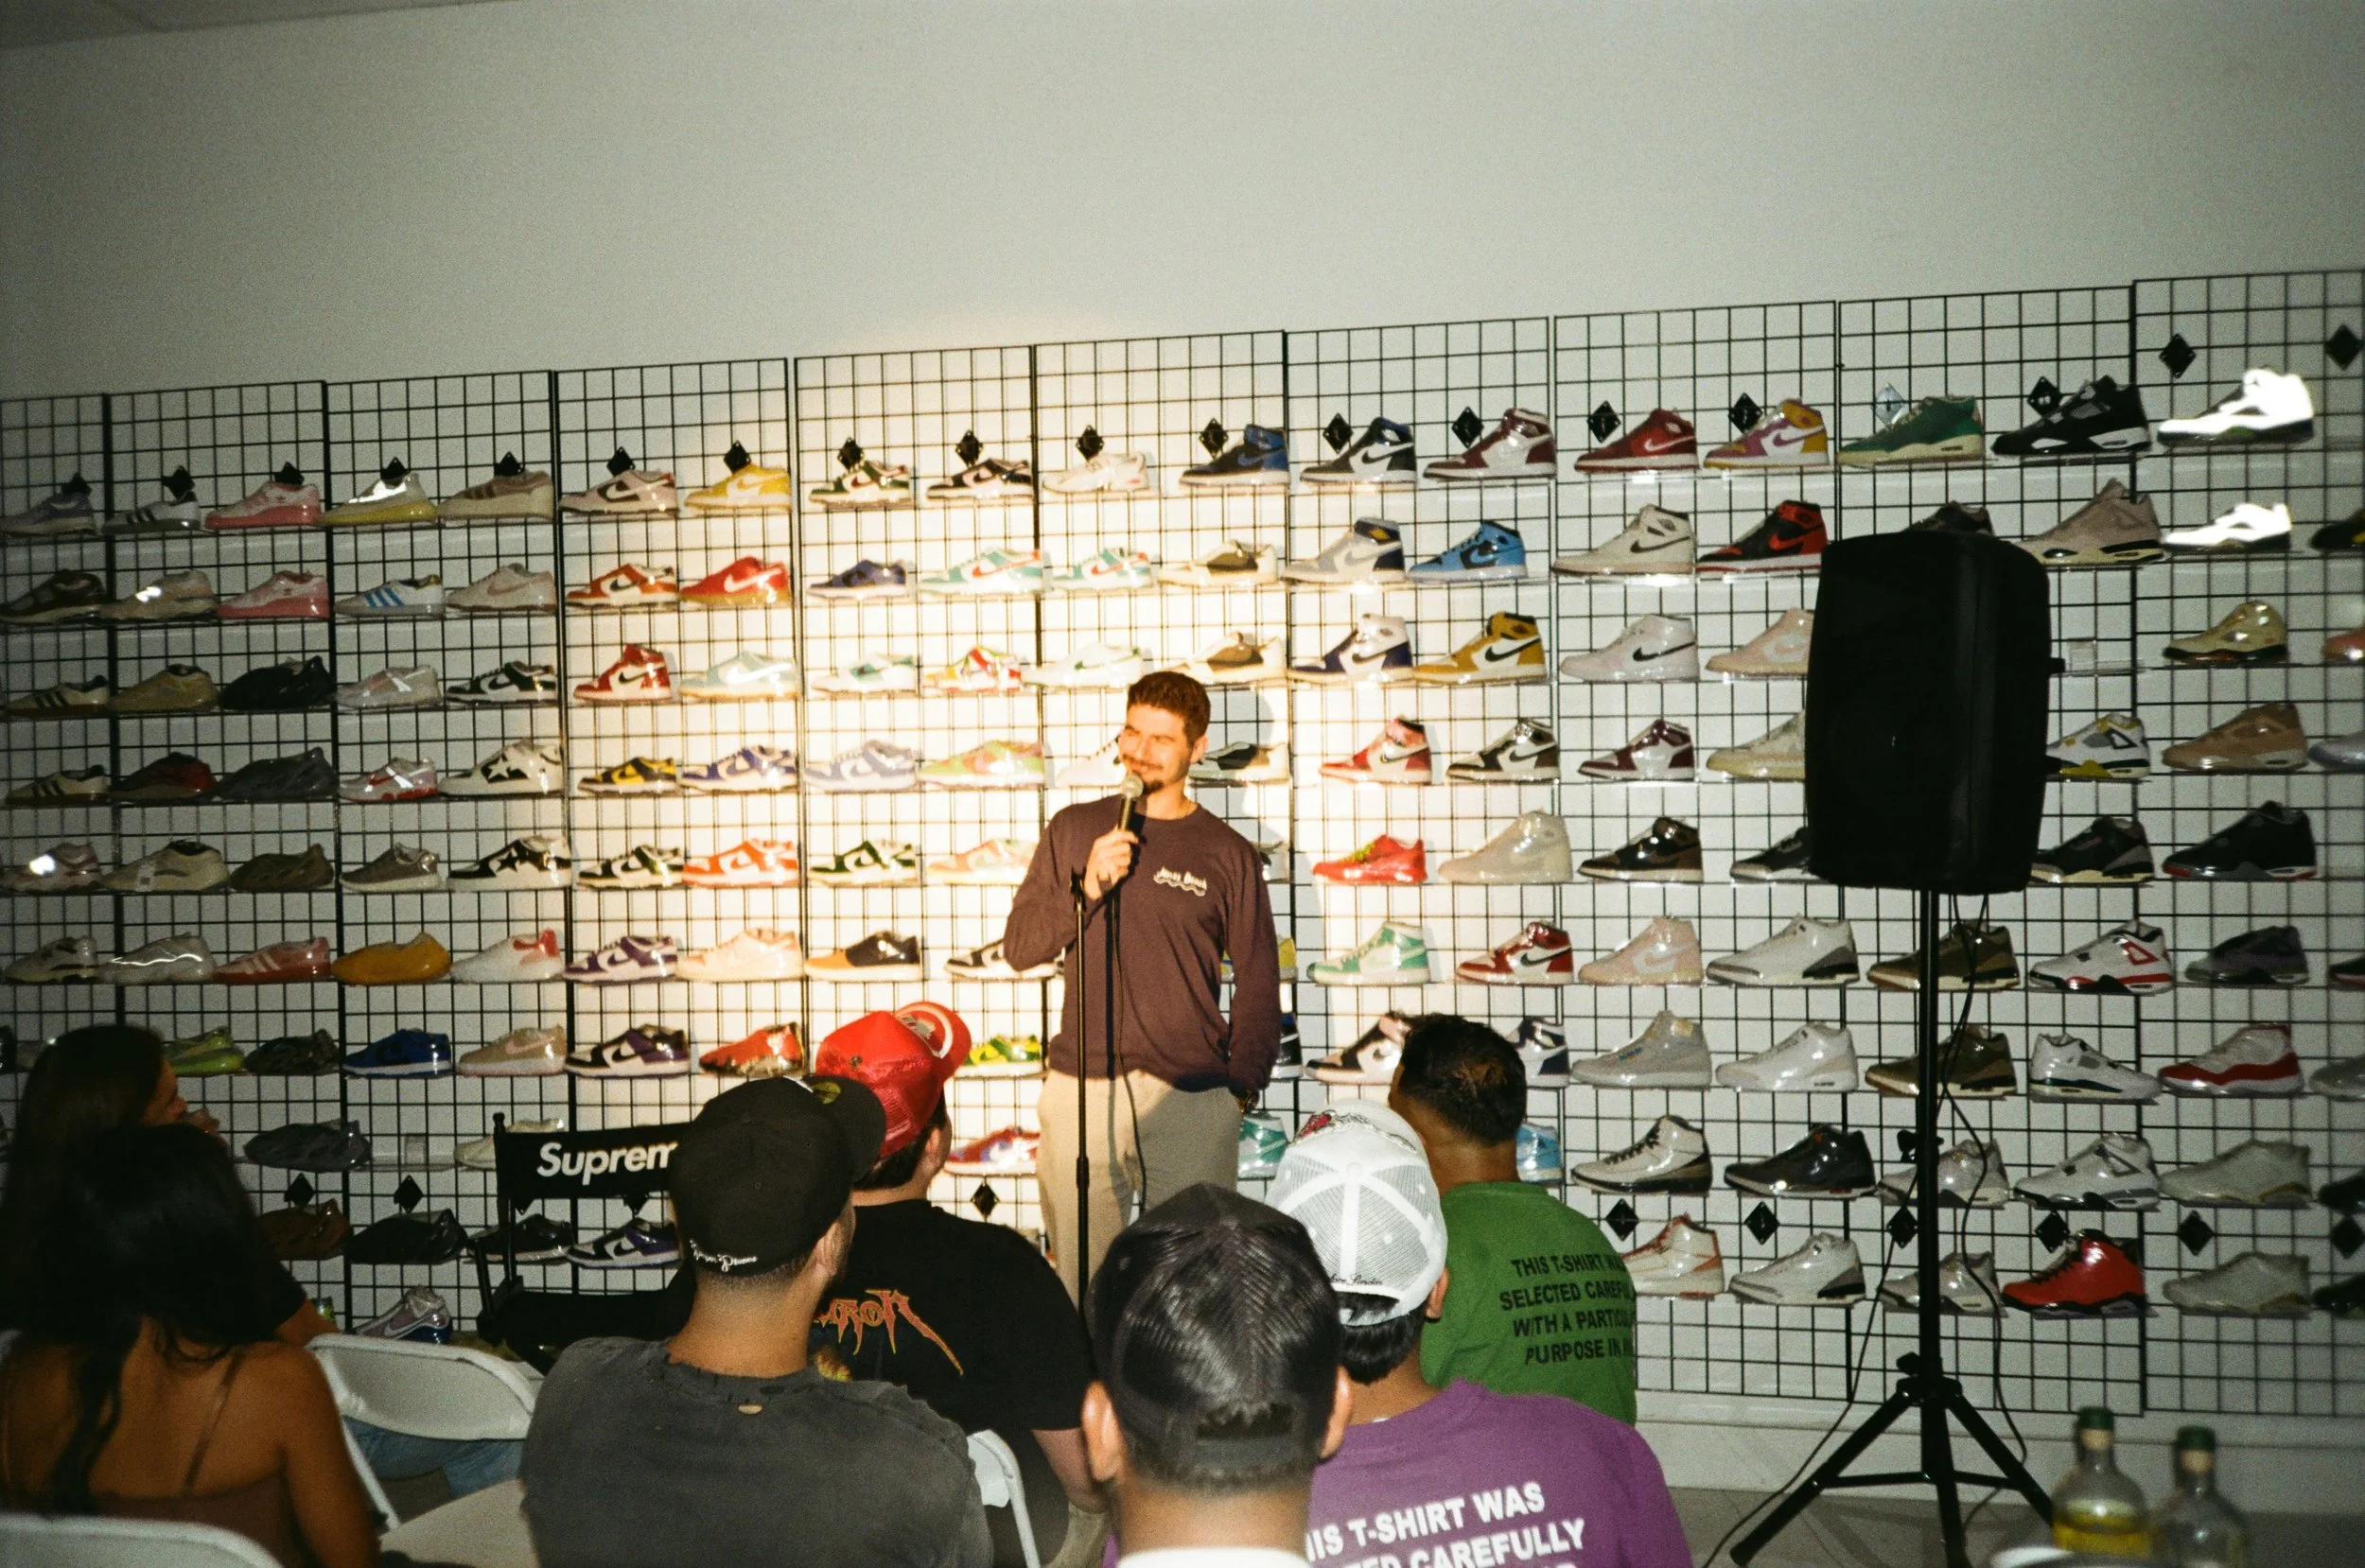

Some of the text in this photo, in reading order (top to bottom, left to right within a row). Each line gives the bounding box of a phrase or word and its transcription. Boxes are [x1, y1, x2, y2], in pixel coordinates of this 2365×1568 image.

[1511, 1256, 1550, 1278] THIS
[1550, 1254, 1604, 1273] T-SHIRT
[1498, 1282, 1582, 1311] SELECTED
[1514, 1313, 1558, 1337] WITH
[1563, 1313, 1572, 1332] A
[1525, 1339, 1604, 1366] PURPOSE
[1609, 1338, 1621, 1357] IN
[1347, 1497, 1465, 1547] T-SHIRT
[1472, 1481, 1546, 1524] WAS
[1410, 1518, 1585, 1568] CAREFULLY
